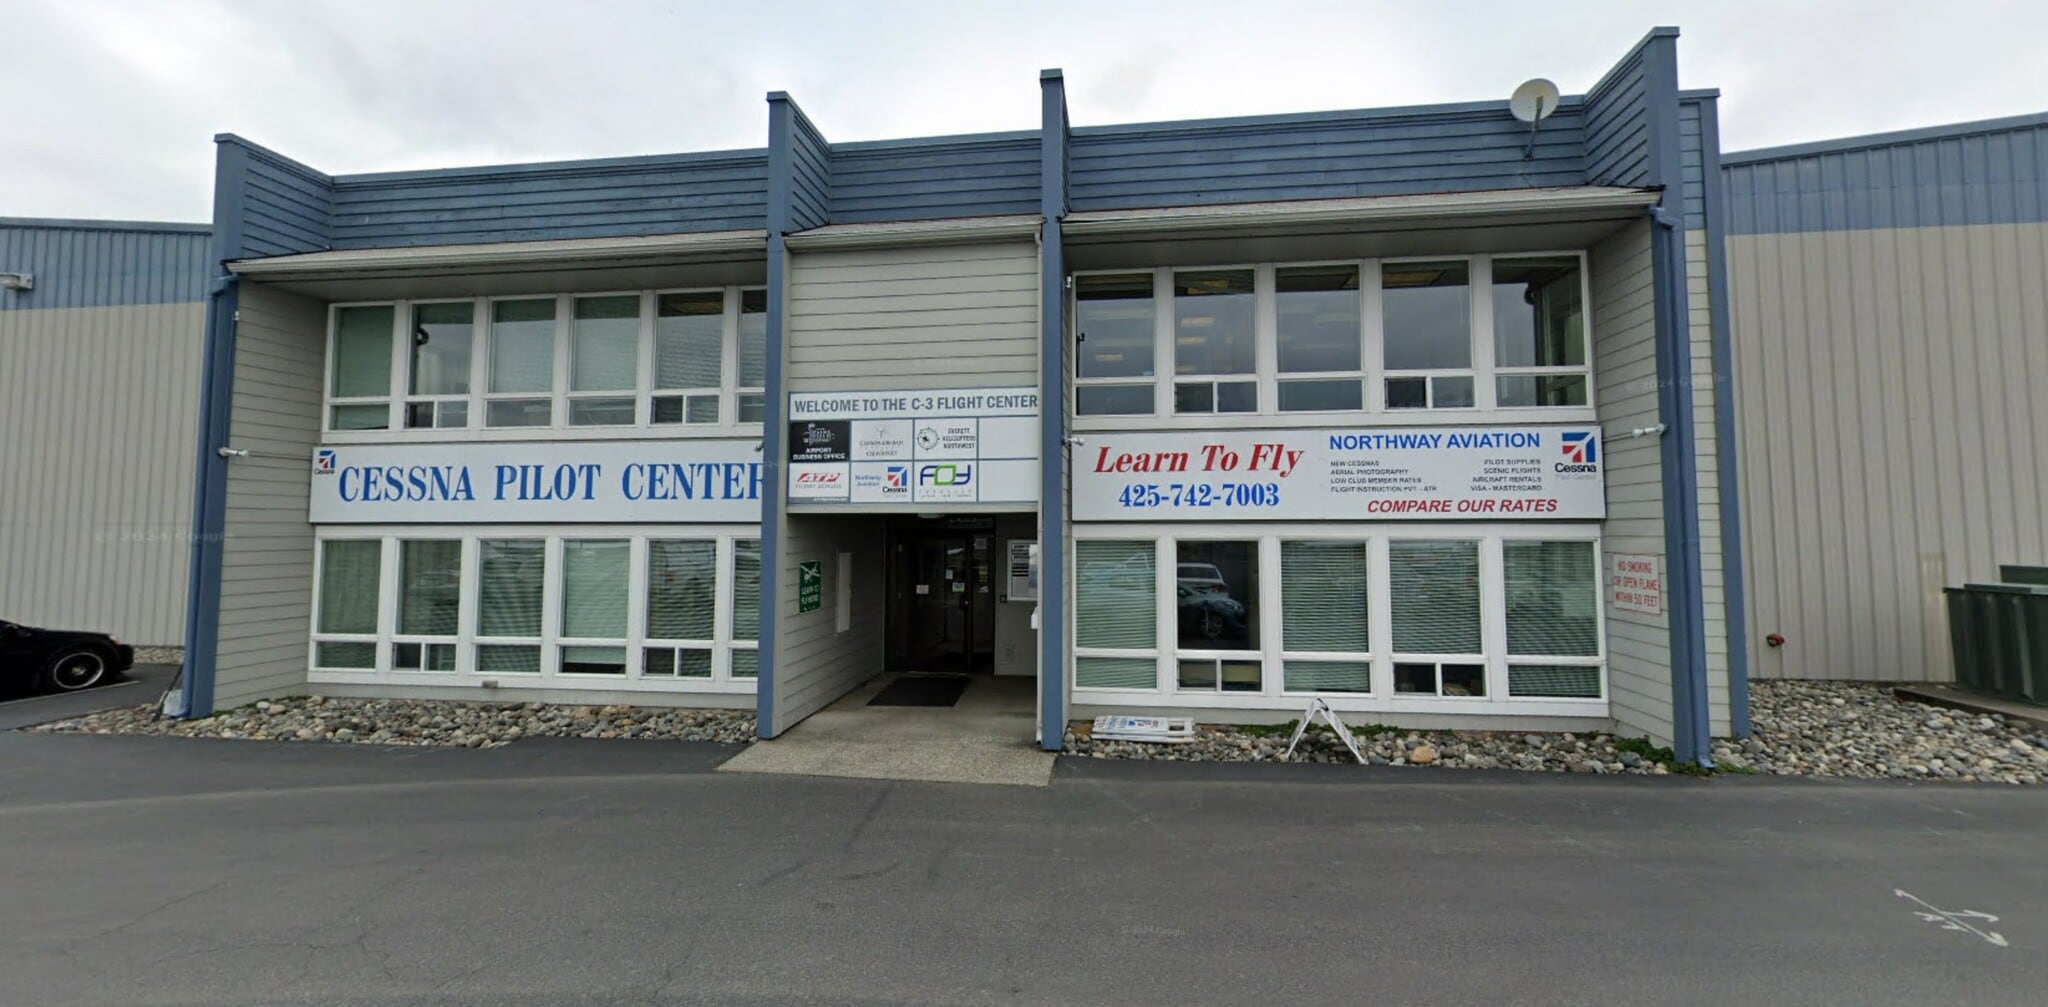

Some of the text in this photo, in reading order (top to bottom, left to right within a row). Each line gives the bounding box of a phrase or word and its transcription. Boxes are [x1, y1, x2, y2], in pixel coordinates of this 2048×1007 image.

[794, 394, 1038, 413] WELCOME TO THE C-3 FLIGHT CENTER
[1329, 432, 1540, 450] NORTHWAY AVIATION
[1093, 443, 1304, 478] Learn To Fly
[1554, 462, 1597, 473] Cessna
[338, 465, 476, 502] CESSNA
[494, 463, 601, 501] PILOT
[1119, 483, 1280, 508] 425-742-7003
[1367, 498, 1558, 513] COMPARE OUR RATES
[1618, 561, 1652, 574] NO SMOKING
[1623, 576, 1638, 588] OPEN
[1639, 577, 1659, 591] FLAME
[1634, 593, 1642, 605] 50
[1643, 594, 1658, 607] FEET
